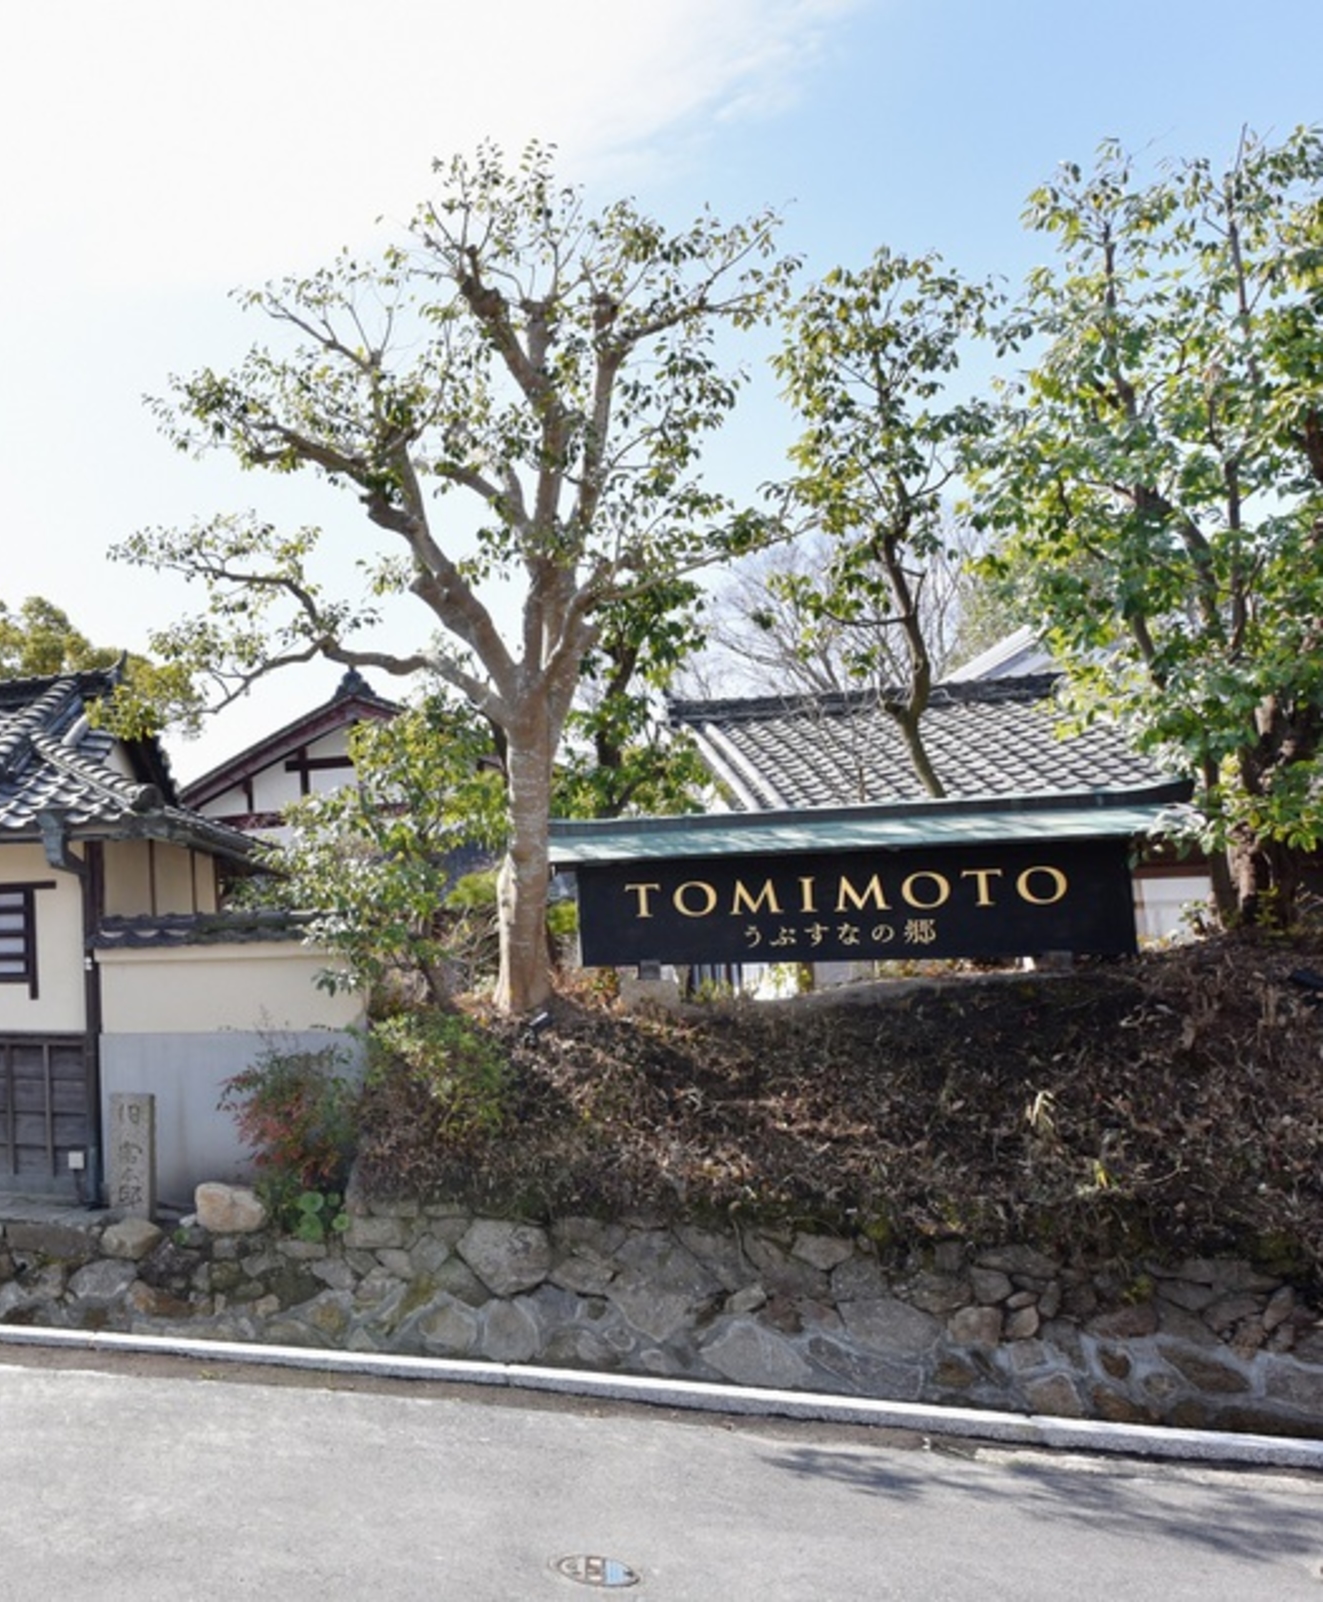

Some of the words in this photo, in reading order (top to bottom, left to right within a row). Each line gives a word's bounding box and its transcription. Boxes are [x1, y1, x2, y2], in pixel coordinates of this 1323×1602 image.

[624, 865, 1069, 918] TOMIMOTO
[744, 919, 937, 948] うぶすなの郷
